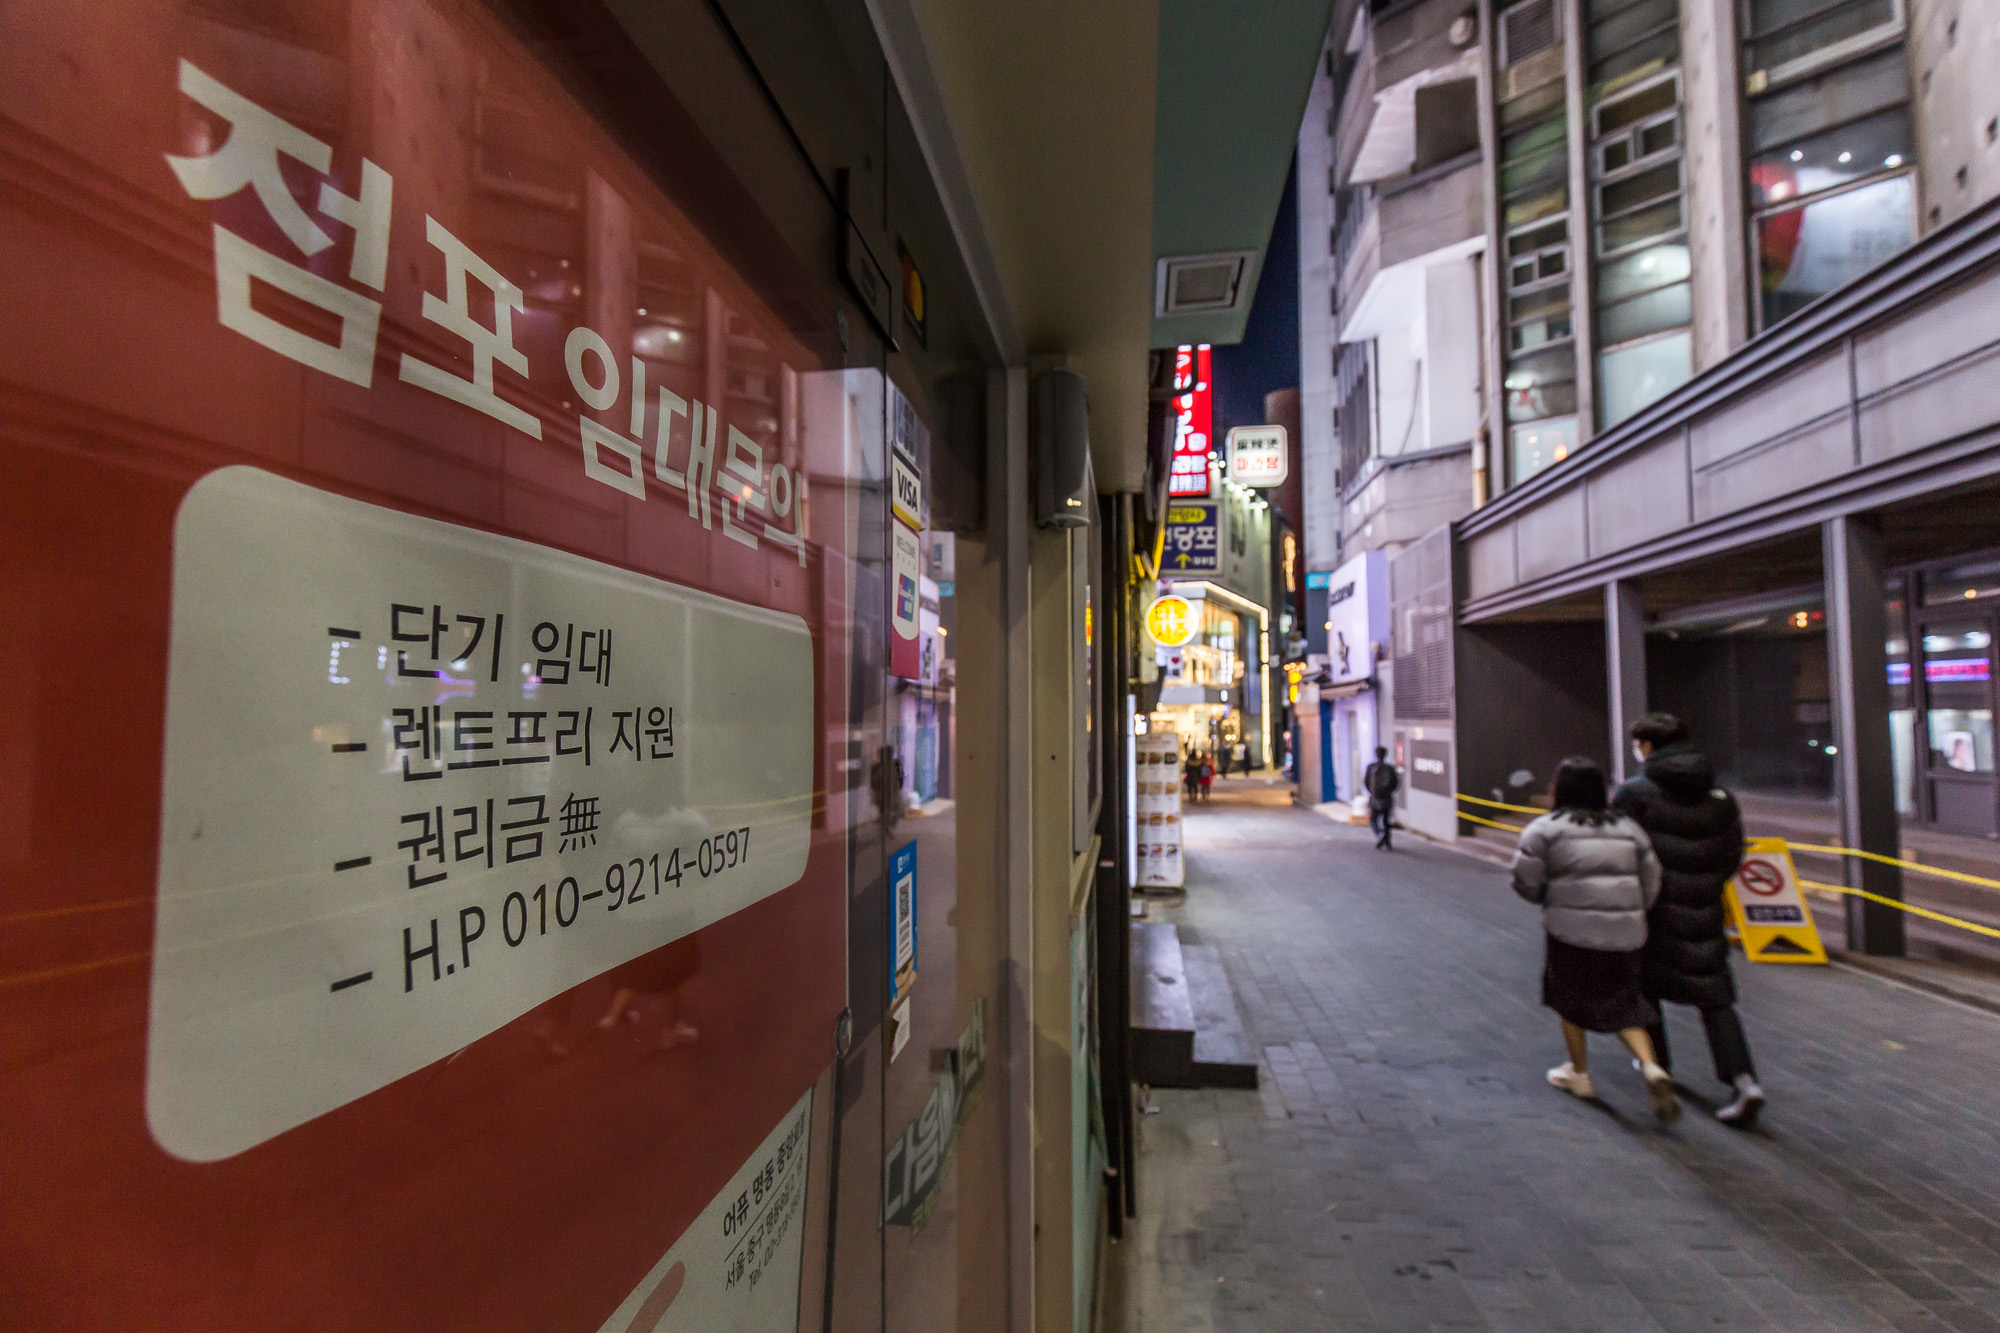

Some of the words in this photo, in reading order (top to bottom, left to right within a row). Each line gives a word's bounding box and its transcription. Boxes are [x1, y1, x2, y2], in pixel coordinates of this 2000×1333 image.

[164, 57, 542, 441] 점포
[564, 327, 807, 568] 임대문의
[896, 468, 918, 512] VISA
[391, 603, 503, 682] 단기
[531, 620, 613, 687] 임대
[393, 705, 593, 782] 렌트프리
[608, 706, 675, 762] 지원
[403, 905, 486, 993] H.P
[502, 827, 751, 948] 010-9214-0597
[723, 1190, 750, 1236] 어퓨
[752, 1157, 775, 1206] 명동
[724, 1251, 746, 1292] 서울
[746, 1223, 765, 1265] 중구
